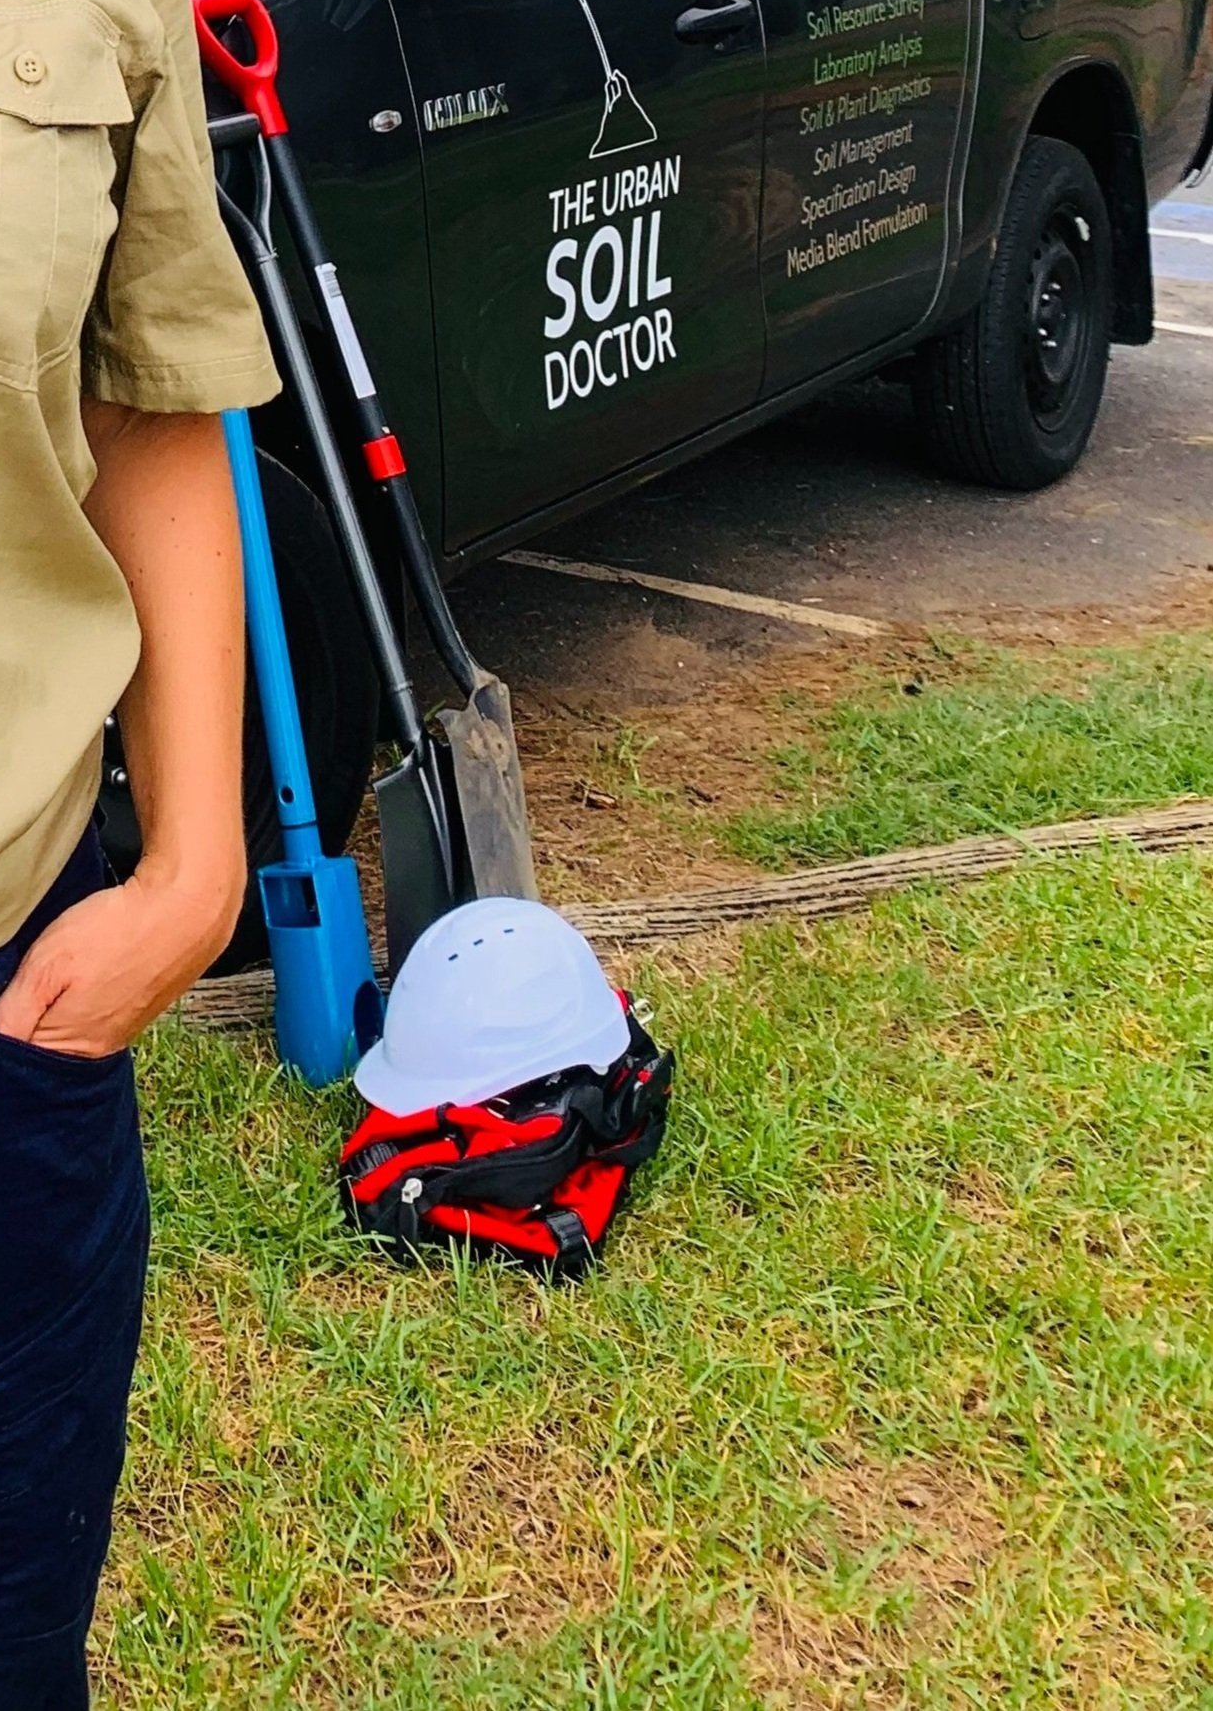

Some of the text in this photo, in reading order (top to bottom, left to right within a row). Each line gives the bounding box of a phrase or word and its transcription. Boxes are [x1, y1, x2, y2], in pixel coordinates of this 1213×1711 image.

[807, 6, 833, 40] Soil
[833, 1, 886, 34] Resource
[814, 30, 923, 86] Laboratory Analysis
[799, 72, 932, 135] Soil & Plant Diagnostics
[813, 120, 914, 176] Soil Management
[549, 155, 681, 233] THE URBAN
[801, 161, 917, 230] Specification Design
[787, 200, 929, 278] Media Blend Formulation
[544, 210, 672, 339] SOIL
[544, 308, 677, 410] DOCTOR
